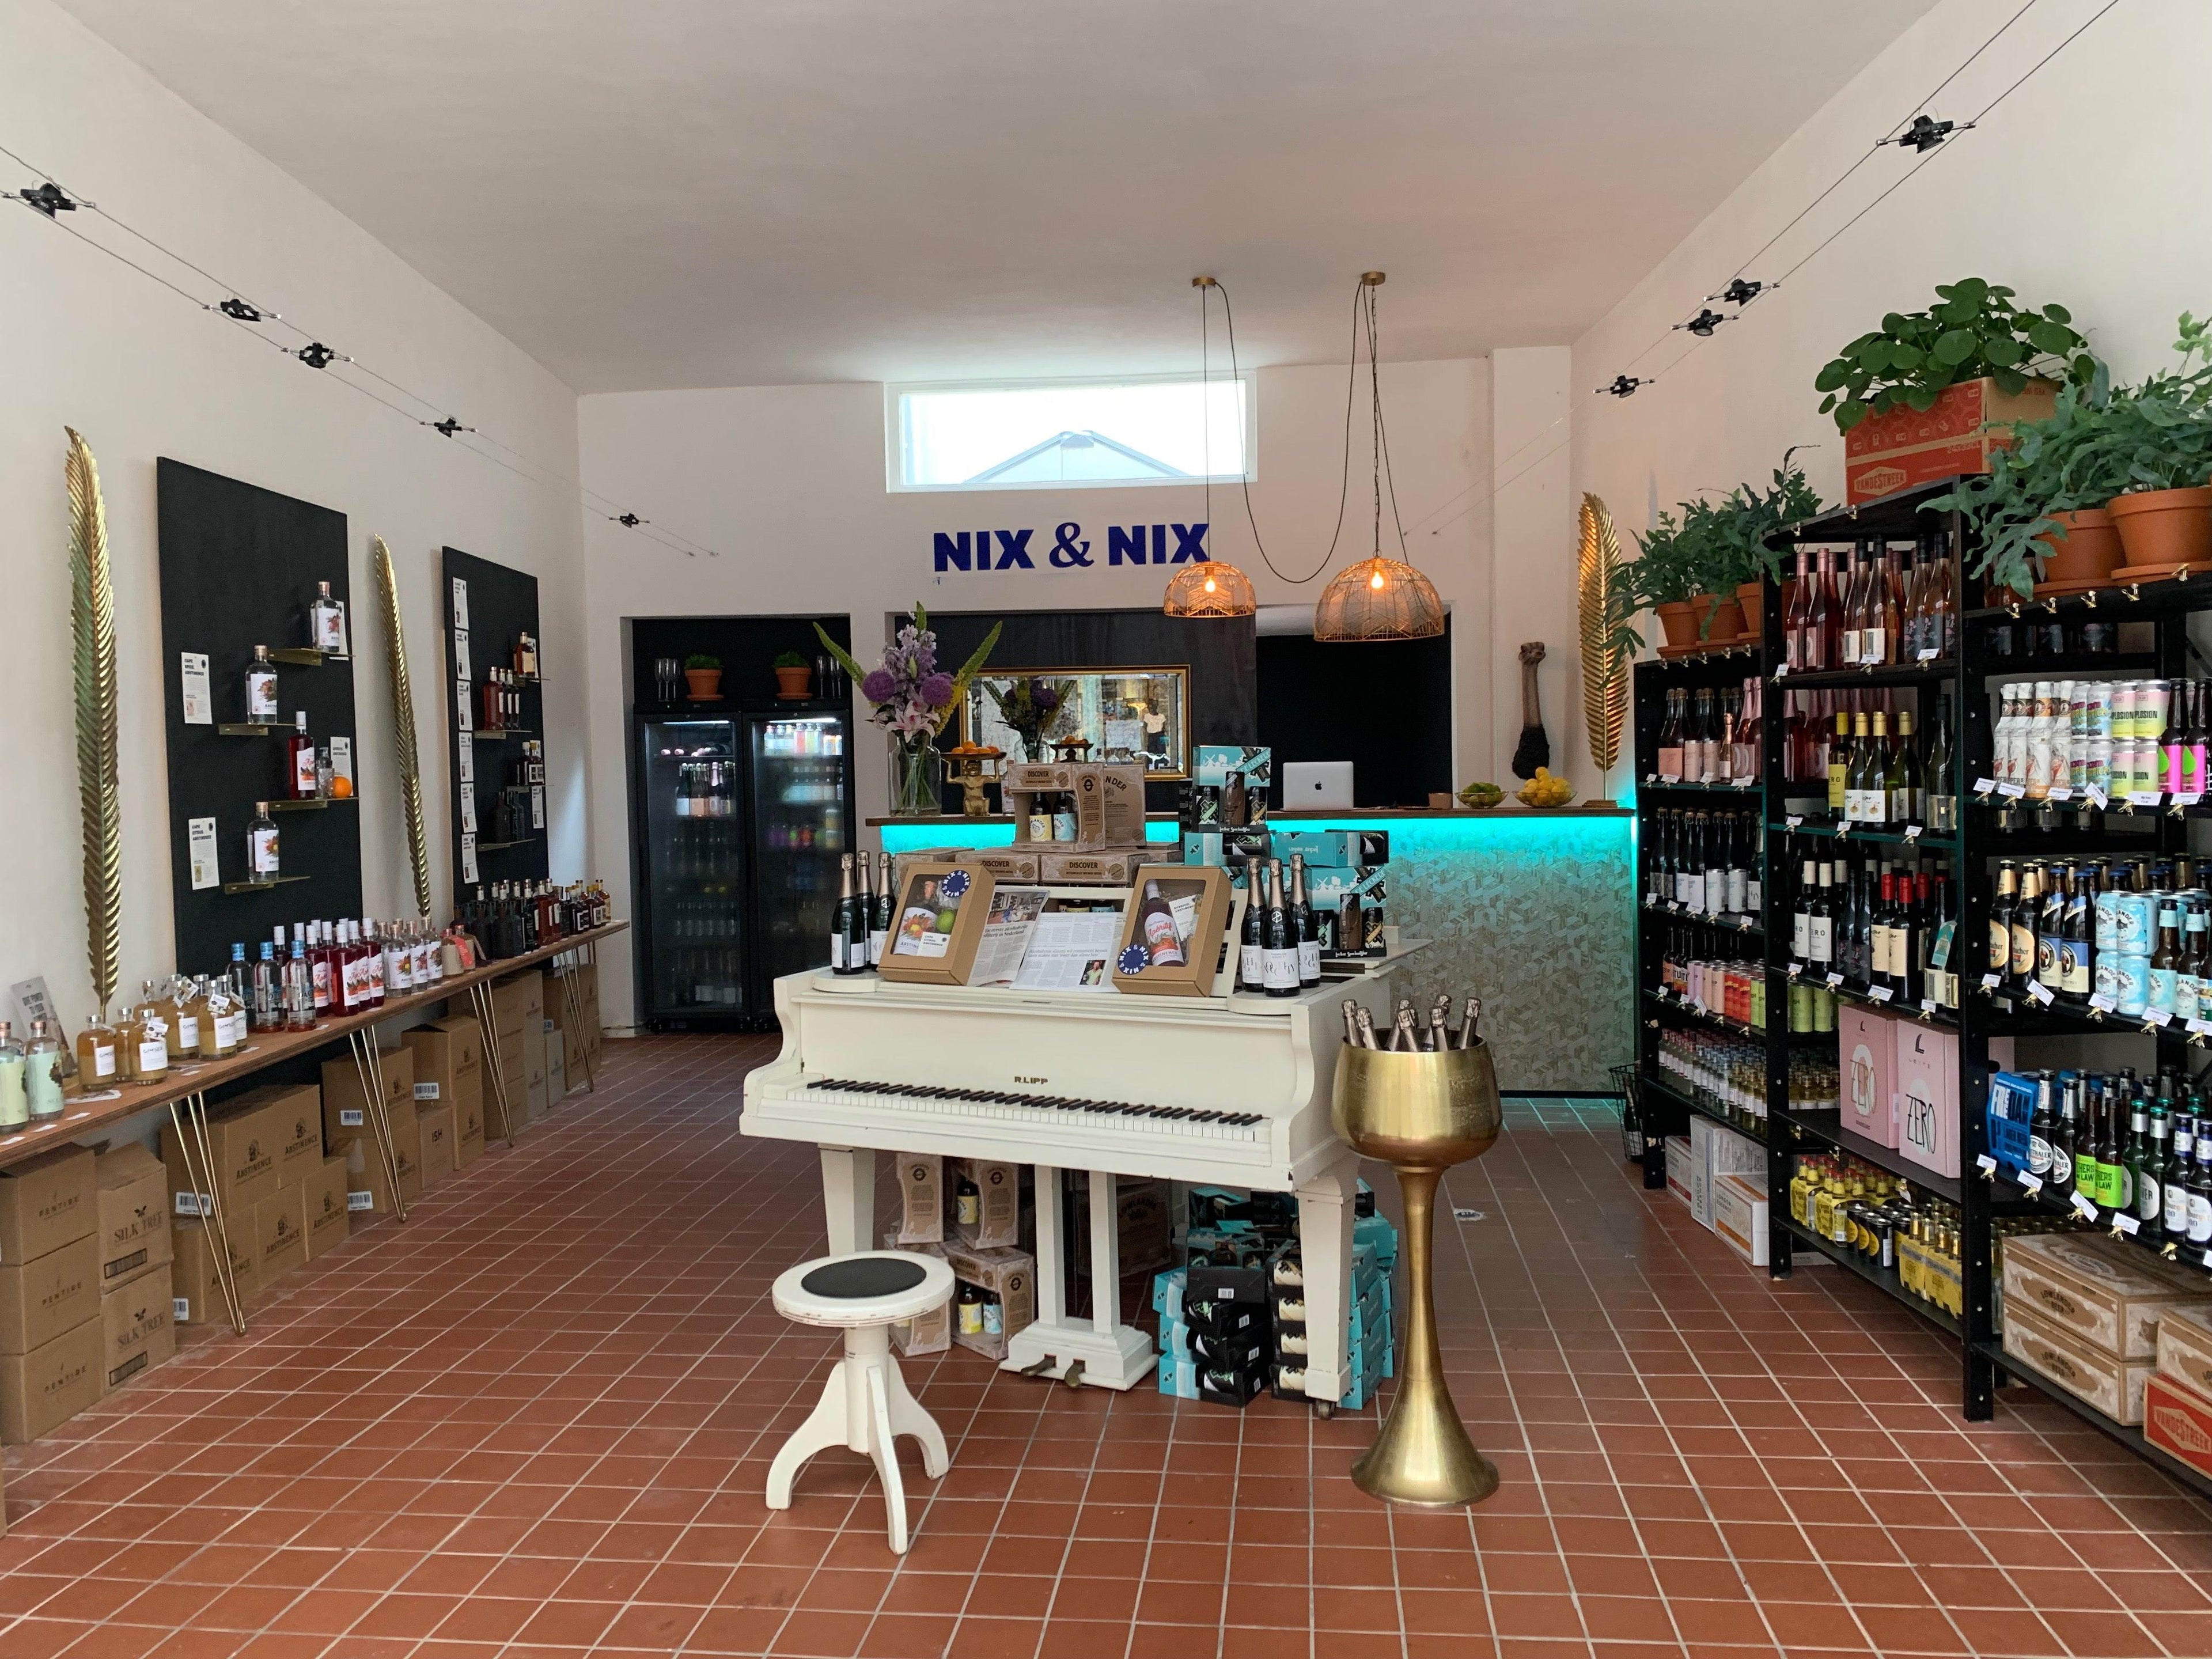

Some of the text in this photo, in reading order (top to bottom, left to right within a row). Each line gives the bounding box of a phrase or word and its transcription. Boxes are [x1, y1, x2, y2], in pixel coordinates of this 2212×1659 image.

[933, 522, 1210, 571] NIX & NIX
[2112, 711, 2134, 719] PLOSION
[2134, 711, 2158, 719] PLOSION
[1105, 775, 1127, 791] NDER
[943, 872, 955, 884] NIX
[1119, 946, 1131, 961] NIX
[1139, 946, 1149, 960] NIX
[1860, 1020, 1865, 1032] L
[1915, 1034, 1925, 1054] L
[1850, 1059, 1877, 1114] ZERO
[1906, 1094, 1937, 1154] ZERO
[285, 1134, 317, 1155] ABSTINENCE
[431, 1128, 443, 1143] ISH
[236, 1156, 272, 1180] ABSTINENCE
[2099, 1181, 2111, 1190] LAW
[114, 1211, 163, 1243] SILK TREE
[266, 1229, 300, 1254] ABSTINENCE
[42, 1282, 82, 1306] PENTIRE
[118, 1312, 165, 1347] SILK TREE
